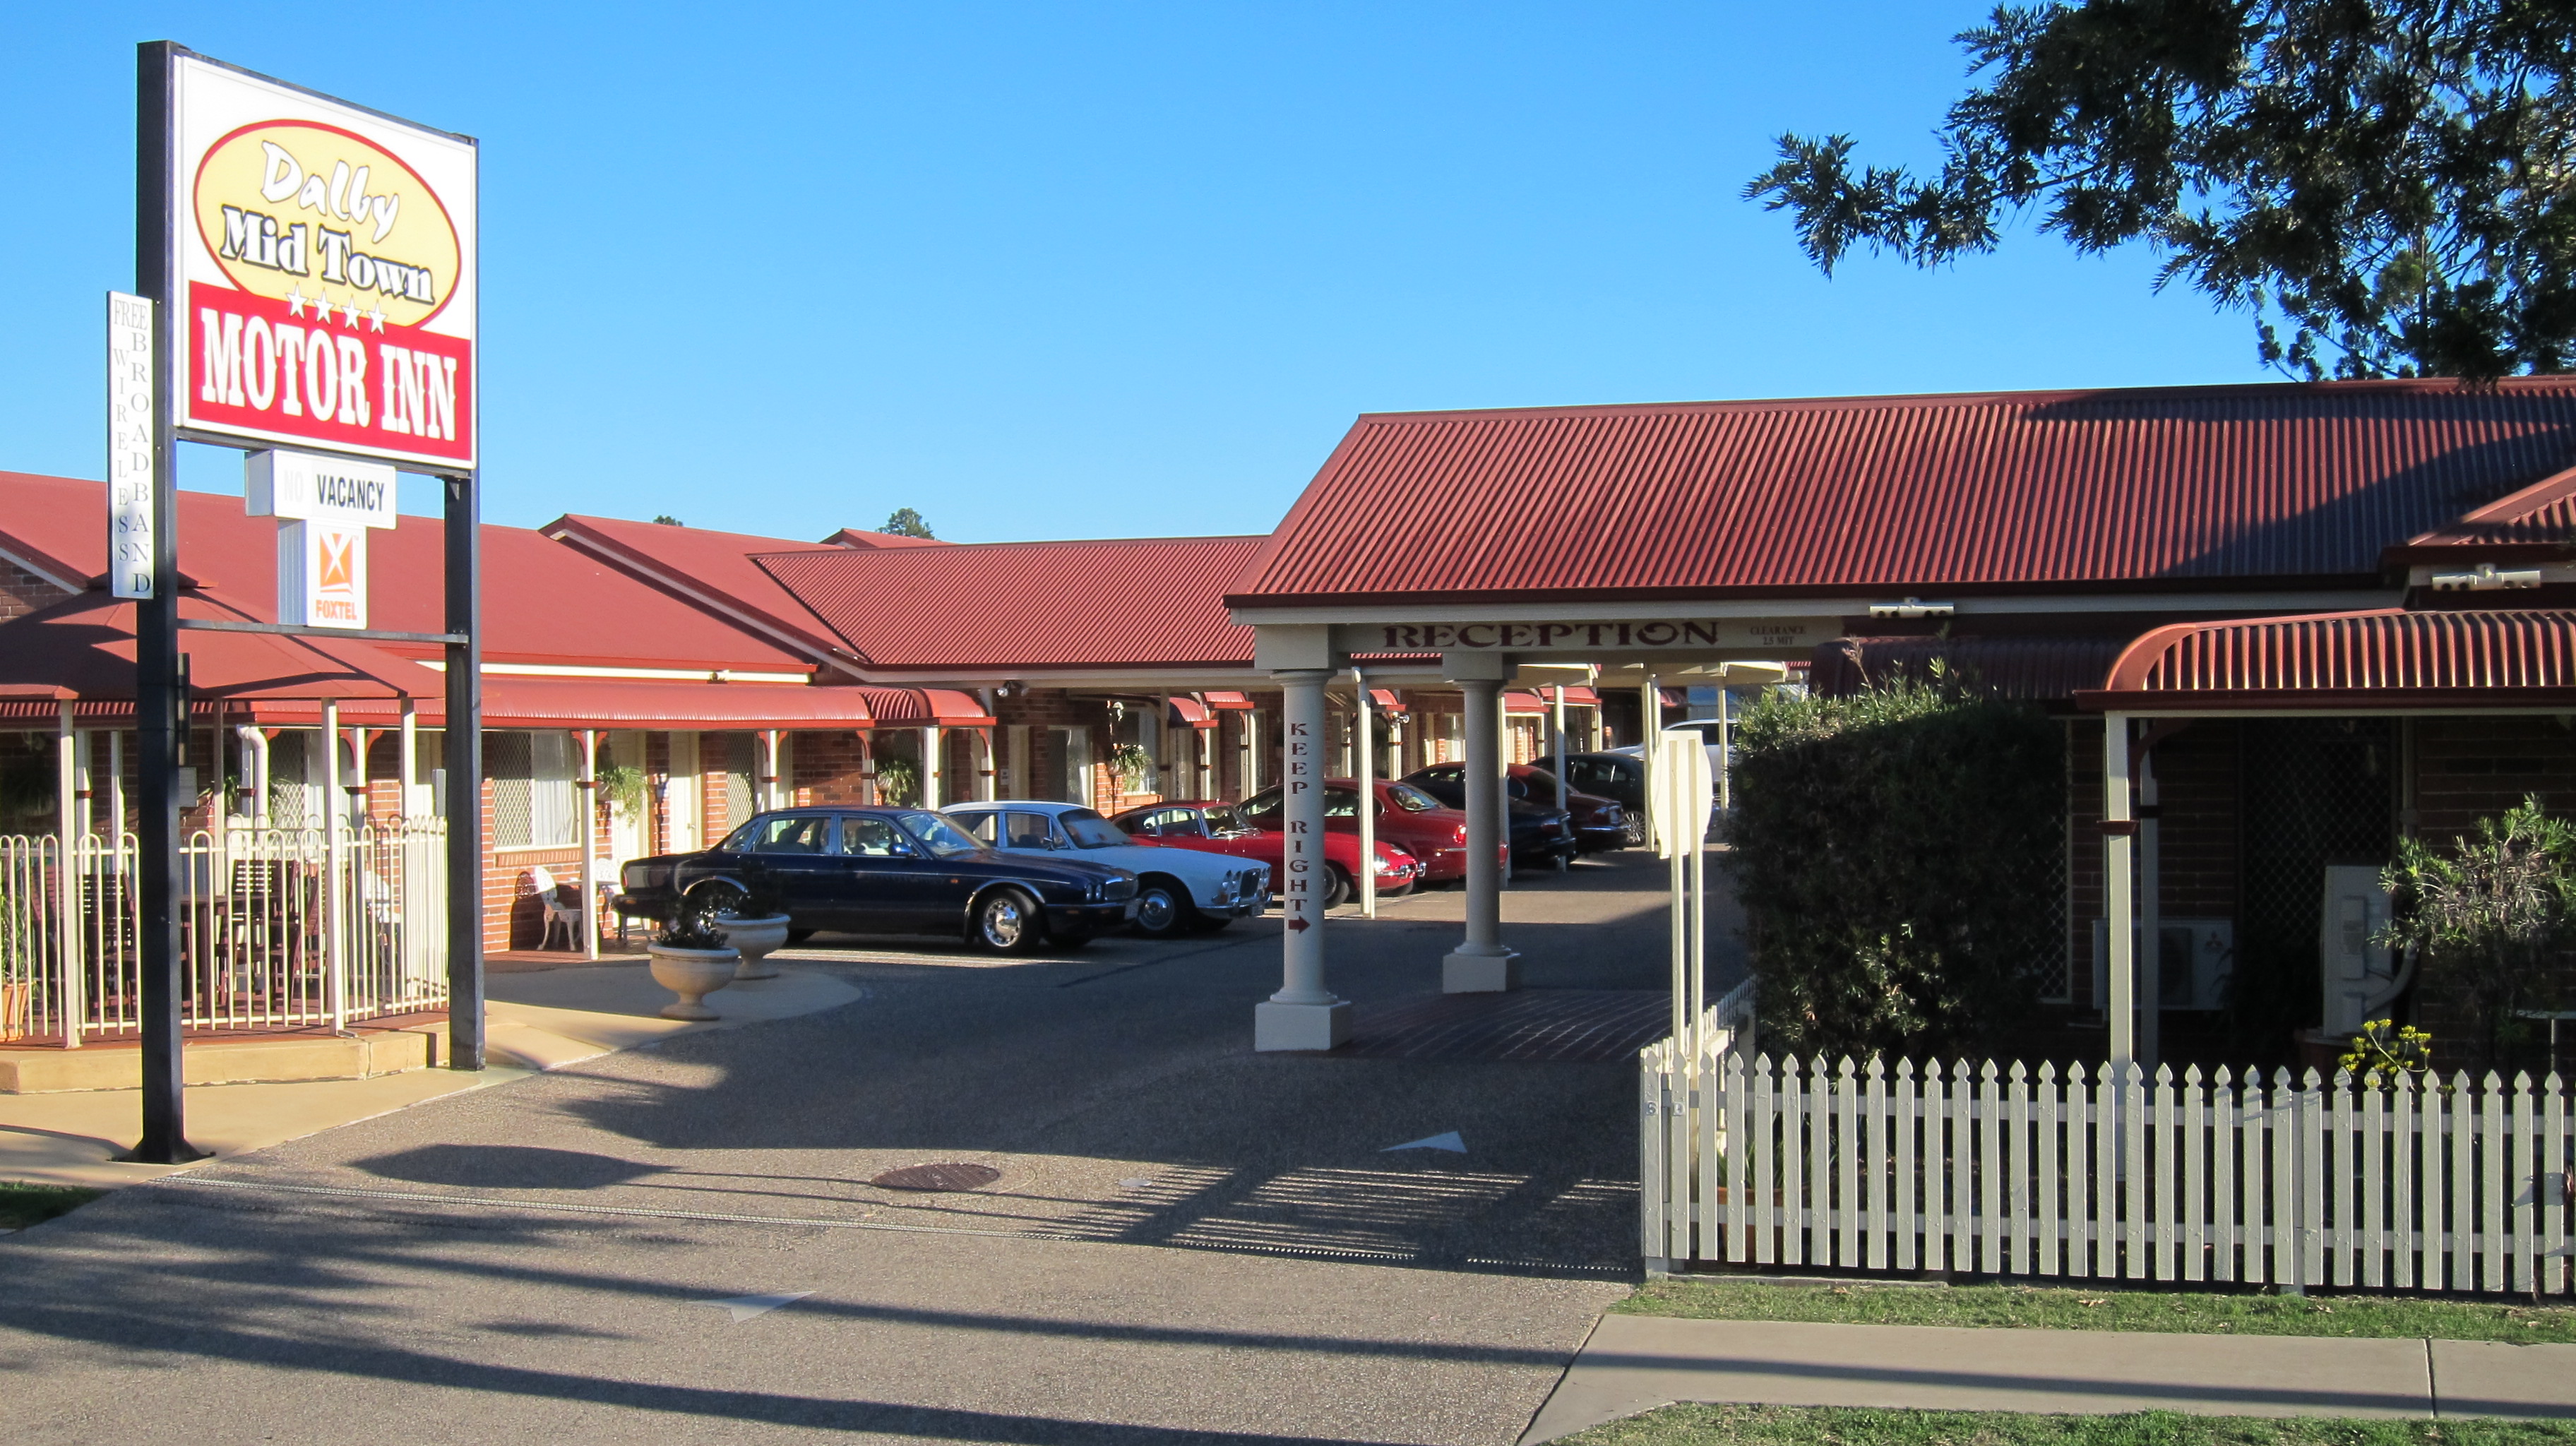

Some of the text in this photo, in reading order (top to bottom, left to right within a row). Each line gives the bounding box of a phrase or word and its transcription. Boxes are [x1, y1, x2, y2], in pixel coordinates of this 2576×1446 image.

[261, 140, 400, 244] Dalby
[220, 204, 435, 306] Mid Town
[114, 299, 148, 330] FREE
[201, 307, 457, 441] MOTOR INN
[113, 348, 130, 562] WIRELESS
[131, 332, 151, 593] BROADBAND
[283, 470, 385, 512] NO VACANCY
[316, 599, 357, 620] FOXTEL
[1382, 621, 1719, 648] RECEPTION
[1750, 626, 1807, 635] CLEARANCE
[1289, 723, 1308, 912] KEEP RIGHT
